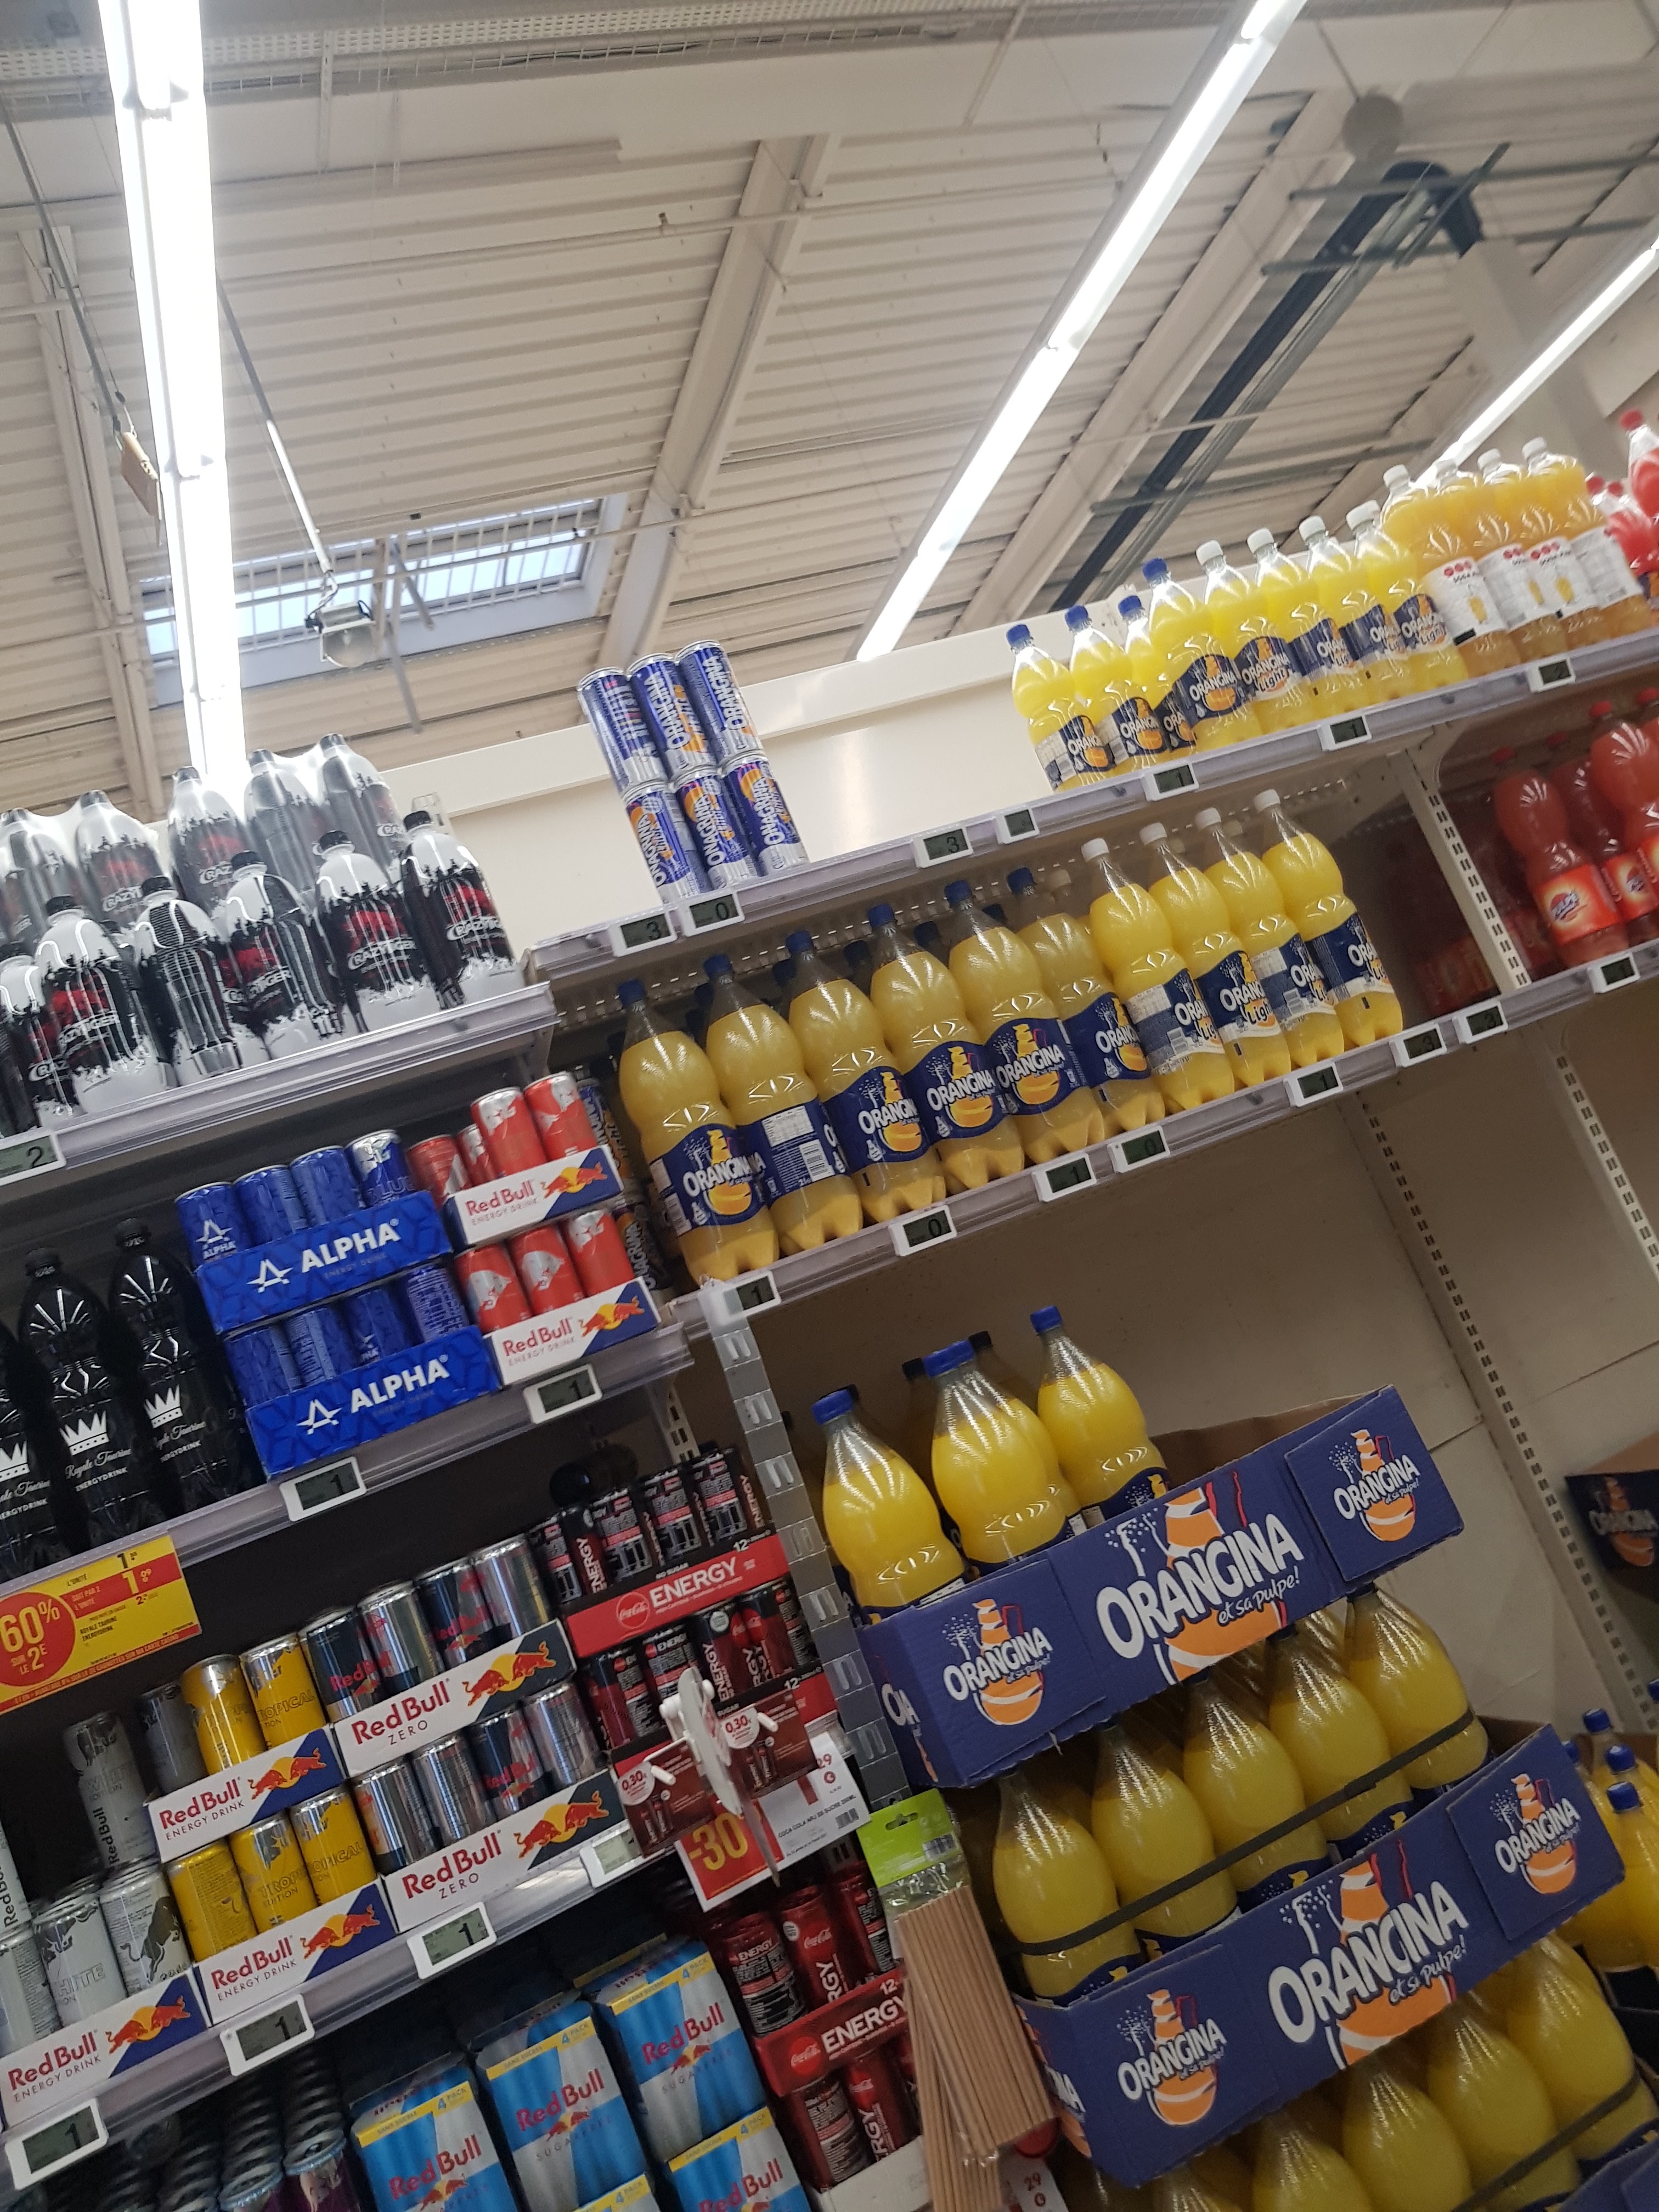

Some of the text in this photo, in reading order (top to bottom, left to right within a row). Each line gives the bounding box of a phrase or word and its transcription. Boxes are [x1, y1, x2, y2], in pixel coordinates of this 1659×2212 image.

[706, 656, 746, 730] ORANGINA
[1189, 671, 1237, 701] ORANGINA
[1241, 653, 1289, 686] ORANGINA
[648, 671, 690, 750] ORANGINA
[926, 1069, 995, 1111] ORANGINA
[996, 1044, 1065, 1088] ORANGINA
[26, 1147, 44, 1167] 2
[466, 1180, 535, 1217] Red Bull
[202, 1240, 237, 1260] ALPHA
[302, 1223, 401, 1273] ALPHA
[928, 1217, 942, 1237] 0
[503, 1318, 573, 1357] Red Bull
[351, 1359, 449, 1413] ALPHA
[14, 1480, 50, 1497] Taurine
[65, 1448, 132, 1480] Royale Taurine
[75, 1467, 128, 1492] ENERGYDRINK
[1334, 1453, 1421, 1520] ORANGINA
[576, 1537, 603, 1594] ENERGY
[650, 1556, 737, 1609] ENERGY
[1097, 1513, 1304, 1660] ORANGINA
[1217, 1566, 1300, 1626] et sa pulpe!
[0, 1599, 61, 1653] 60%
[703, 1643, 730, 1702] ENERGY
[943, 1627, 1053, 1701] ORANGINA
[352, 1680, 451, 1745] Red Bull
[387, 1719, 428, 1746] ZERO
[93, 1805, 111, 1836] Bull
[159, 1779, 240, 1830] Red Bull
[166, 1799, 245, 1841] ENERGY DRINK
[1495, 1797, 1581, 1874] ORANGINA
[402, 1832, 503, 1900] Red Bull
[438, 1872, 479, 1900] ZERO
[458, 1922, 474, 1946] 1
[738, 1937, 774, 1962] ENERGY
[211, 1936, 294, 1990] Red Bull
[217, 1959, 298, 2001] ENERGY DRINK
[1268, 1881, 1470, 2044] ORANGINA
[1389, 1934, 1467, 2004] et pulpe!
[274, 2015, 290, 2040] 1
[641, 2002, 725, 2065] Red Bull
[8, 2031, 97, 2090] Red Bull
[14, 2055, 101, 2102] ENERGY DRINK
[1118, 2018, 1227, 2101] ORANGINA
[516, 2068, 605, 2131] Red Bull
[64, 2122, 82, 2149] 1
[388, 2158, 437, 2200] Red
[436, 2134, 483, 2175] Bull
[741, 2157, 784, 2198] Bull
